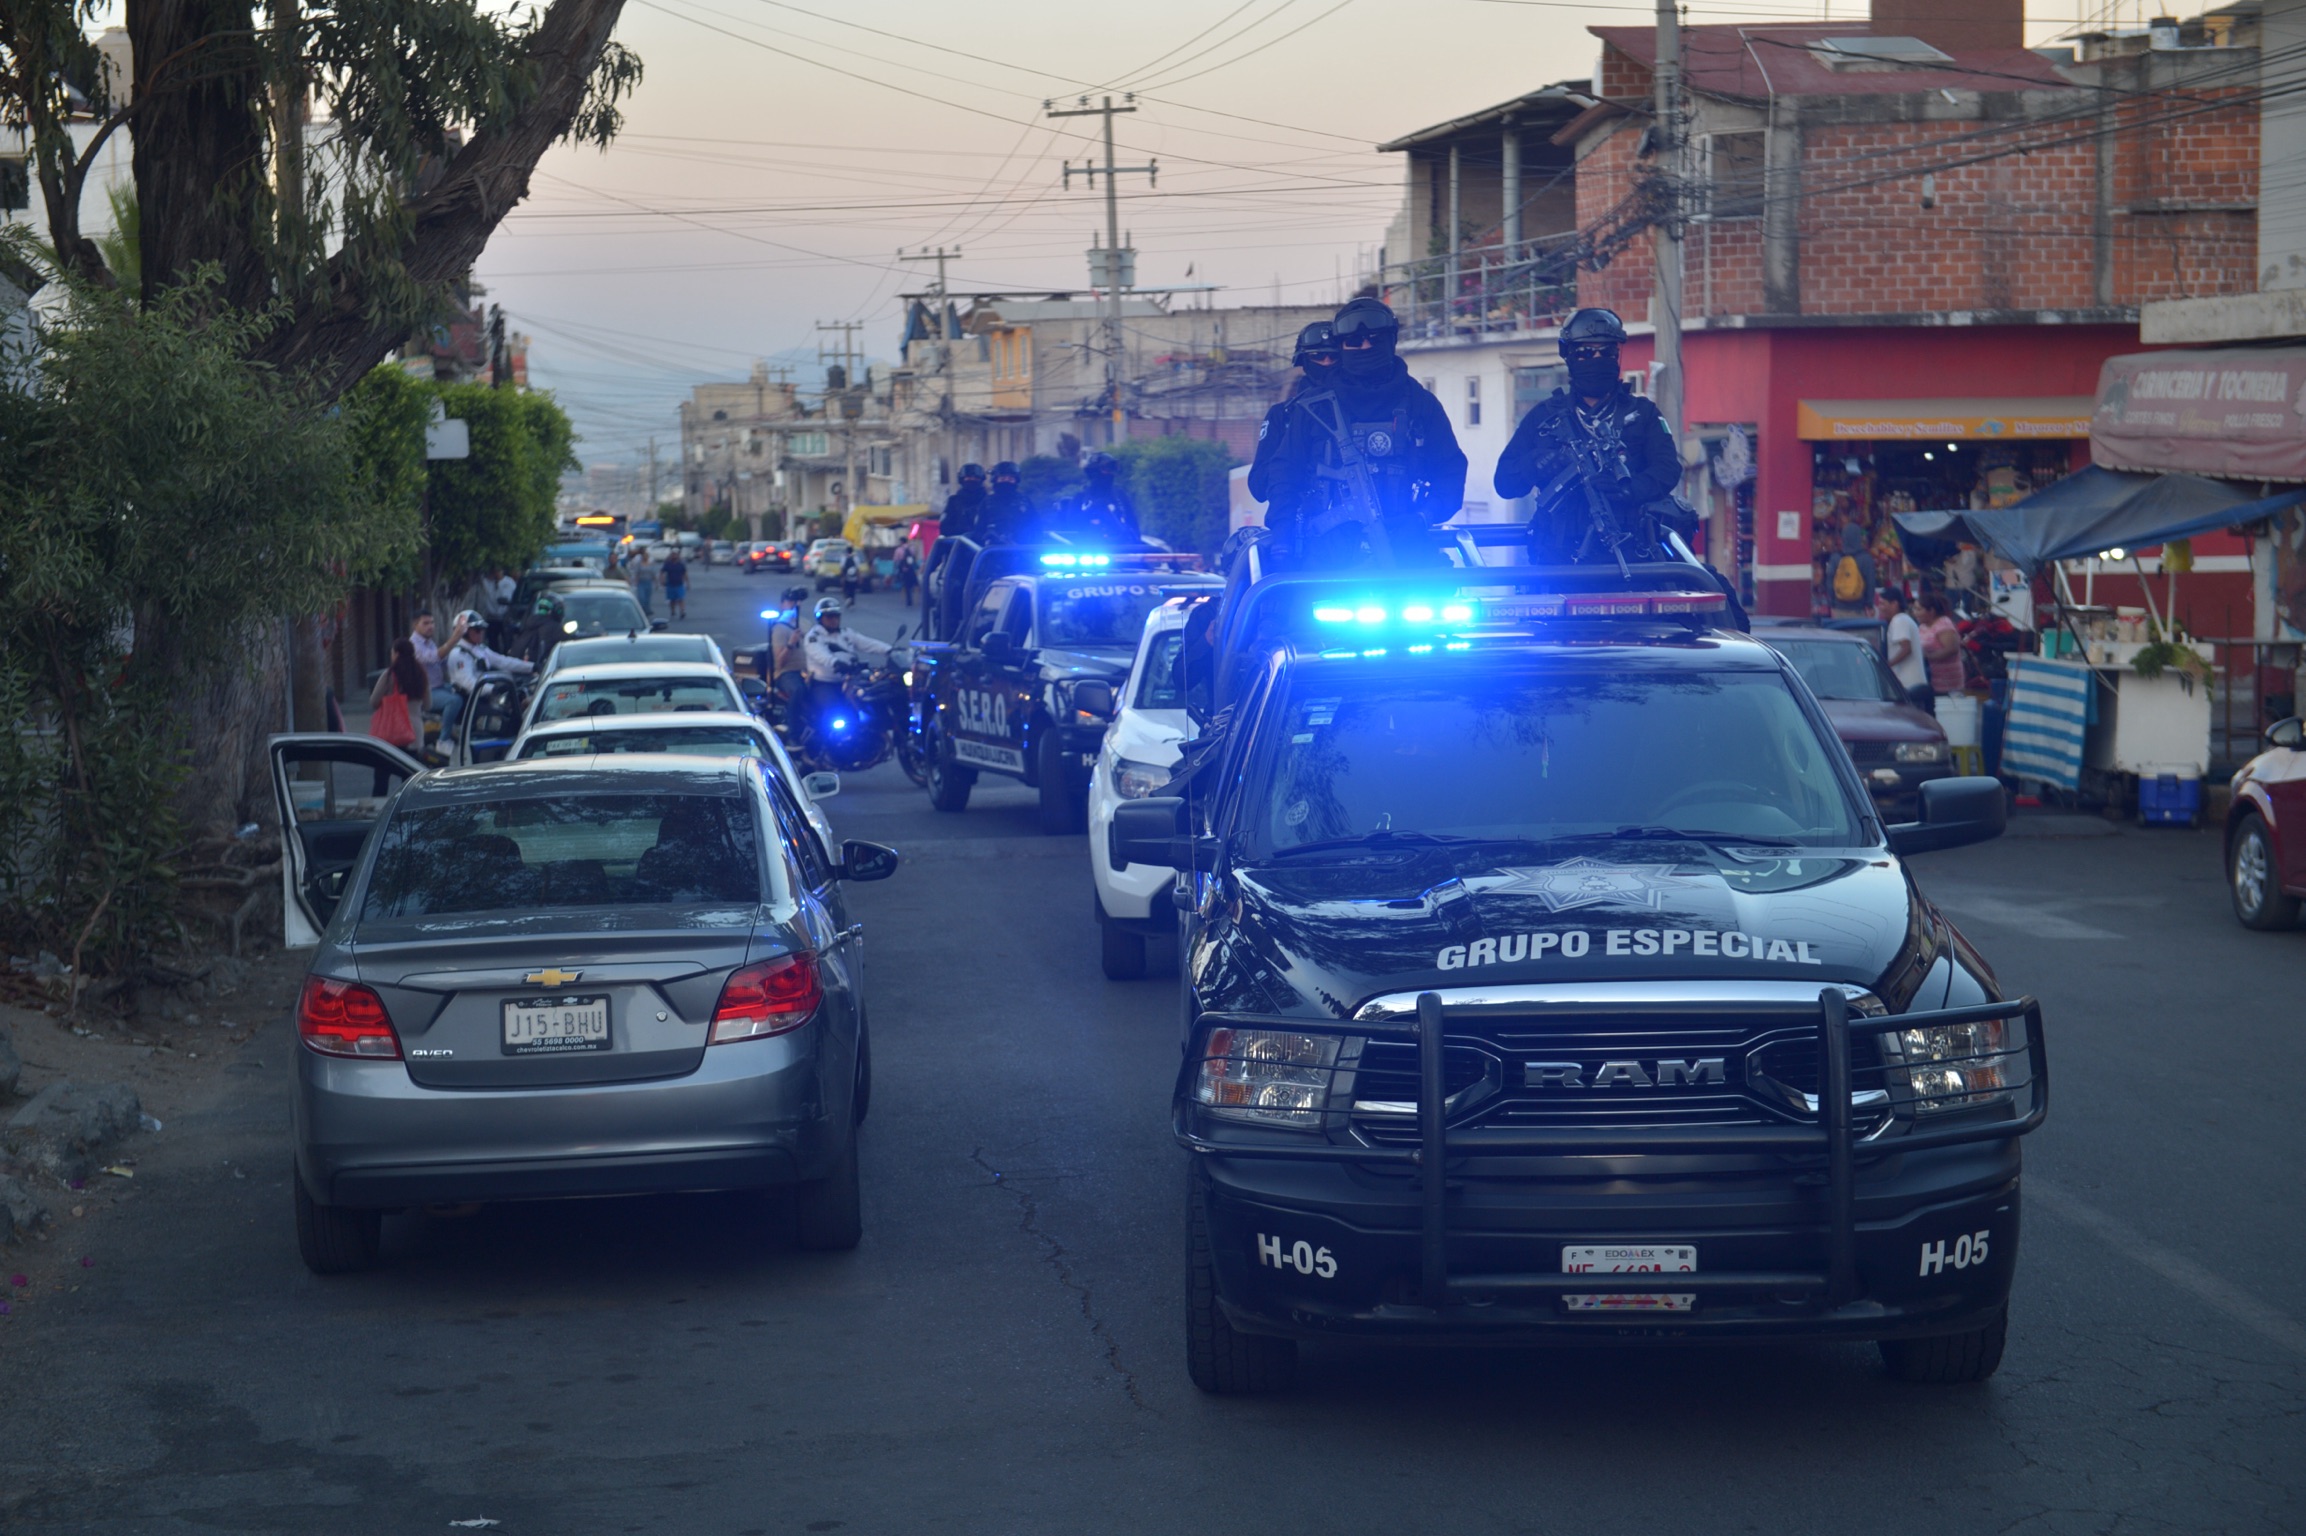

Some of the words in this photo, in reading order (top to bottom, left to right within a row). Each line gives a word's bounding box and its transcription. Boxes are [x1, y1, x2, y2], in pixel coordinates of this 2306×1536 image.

[2203, 371, 2217, 400] Y
[2223, 413, 2250, 428] POLLO
[2250, 413, 2284, 428] FRESCO
[1067, 585, 1145, 599] GRUPO
[957, 688, 1011, 738] S.E.R.O.
[1436, 930, 1590, 971] GRUPO
[1606, 929, 1822, 966] ESPECIAL
[511, 1011, 602, 1037] J15-BHU
[517, 1044, 597, 1053] chevroletiztacalco.com.mx
[532, 1038, 542, 1046] 55
[565, 1036, 584, 1044] 0000
[1524, 1058, 1726, 1088] RAM
[1257, 1232, 1338, 1278] H-05
[1919, 1229, 1990, 1277] H-05
